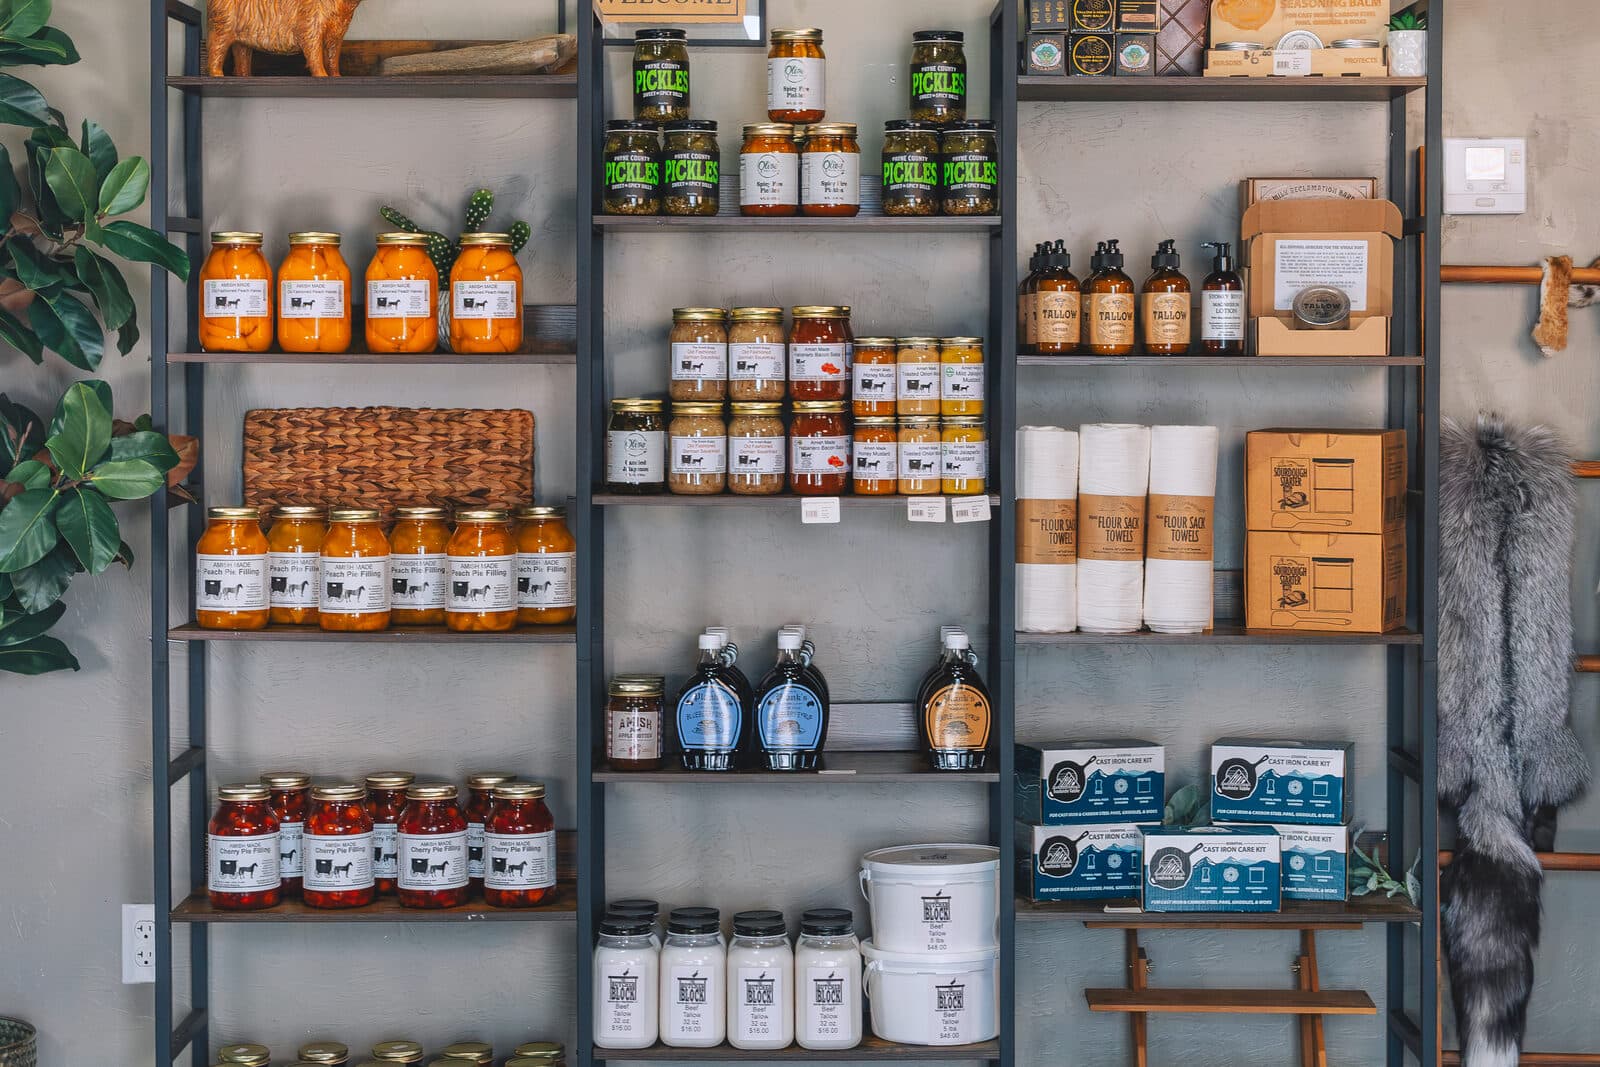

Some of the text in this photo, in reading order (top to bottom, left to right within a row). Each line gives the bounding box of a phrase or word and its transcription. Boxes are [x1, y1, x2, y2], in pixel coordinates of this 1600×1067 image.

[660, 62, 680, 70] COUNTY
[635, 70, 688, 94] PICKLES
[912, 72, 965, 96] PICKLES
[630, 154, 650, 162] COUNTY
[908, 154, 928, 162] COUNTY
[968, 154, 988, 162] COUNTY
[605, 161, 660, 186] PICKLES
[664, 160, 719, 184] PICKLES
[882, 162, 938, 186] PICKLES
[943, 162, 998, 186] PICKLES
[1290, 184, 1338, 194] RECLAMATION
[1303, 302, 1341, 310] TALLOW
[1043, 310, 1078, 319] TALLOW
[1099, 312, 1134, 321] TALLOW
[1152, 310, 1186, 320] TALLOW
[1274, 467, 1308, 478] SOURDOUGH
[1280, 477, 1302, 487] STARTER
[1040, 518, 1064, 531] FLOUR
[1098, 516, 1122, 529] FLOUR
[1124, 516, 1140, 529] SACK
[1163, 516, 1206, 529] FLOUR SACK
[1105, 530, 1134, 543] TOWELS
[1170, 529, 1200, 542] TOWELS
[203, 568, 260, 576] Peach Pie Filling
[360, 570, 381, 578] Filling
[486, 569, 507, 578] Filling
[546, 566, 567, 574] Filling
[1273, 566, 1307, 576] SOURDOUGH
[1280, 576, 1302, 586] STARTER
[619, 716, 652, 730] AMISH
[220, 848, 240, 856] Cherry
[315, 847, 336, 856] Cherry
[410, 846, 430, 854] Cherry
[491, 846, 510, 854] Cherry
[924, 907, 950, 920] BLOCK
[610, 987, 636, 1000] BLOCK
[680, 988, 706, 1002] BLOCK
[747, 990, 773, 1003] BLOCK
[816, 990, 842, 1002] BLOCK
[938, 996, 964, 1009] BLOCK
